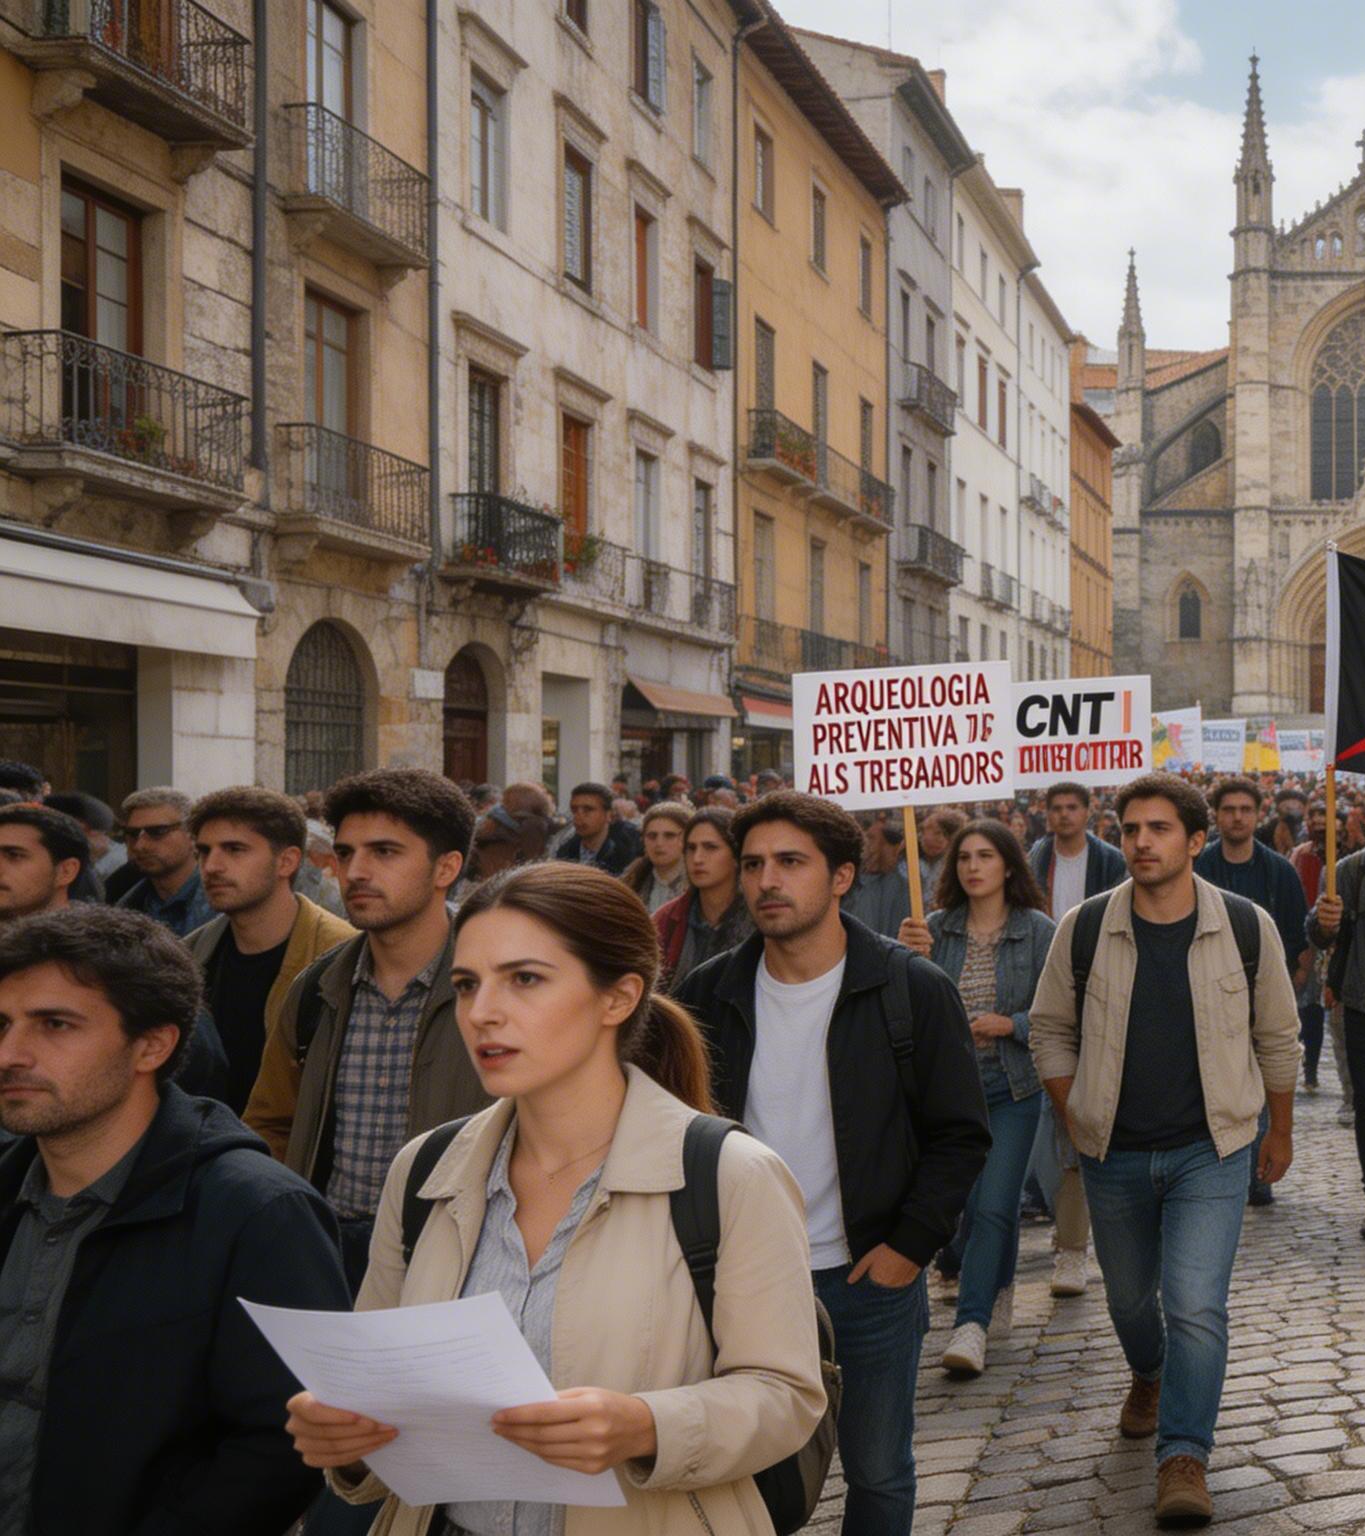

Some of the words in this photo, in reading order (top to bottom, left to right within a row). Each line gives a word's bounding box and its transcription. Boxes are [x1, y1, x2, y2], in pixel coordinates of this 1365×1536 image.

[815, 673, 990, 715] ARQUEOLOGIA
[1016, 692, 1114, 737] CNT
[813, 715, 958, 755] PREVENTIVA
[808, 762, 848, 796] ALS
